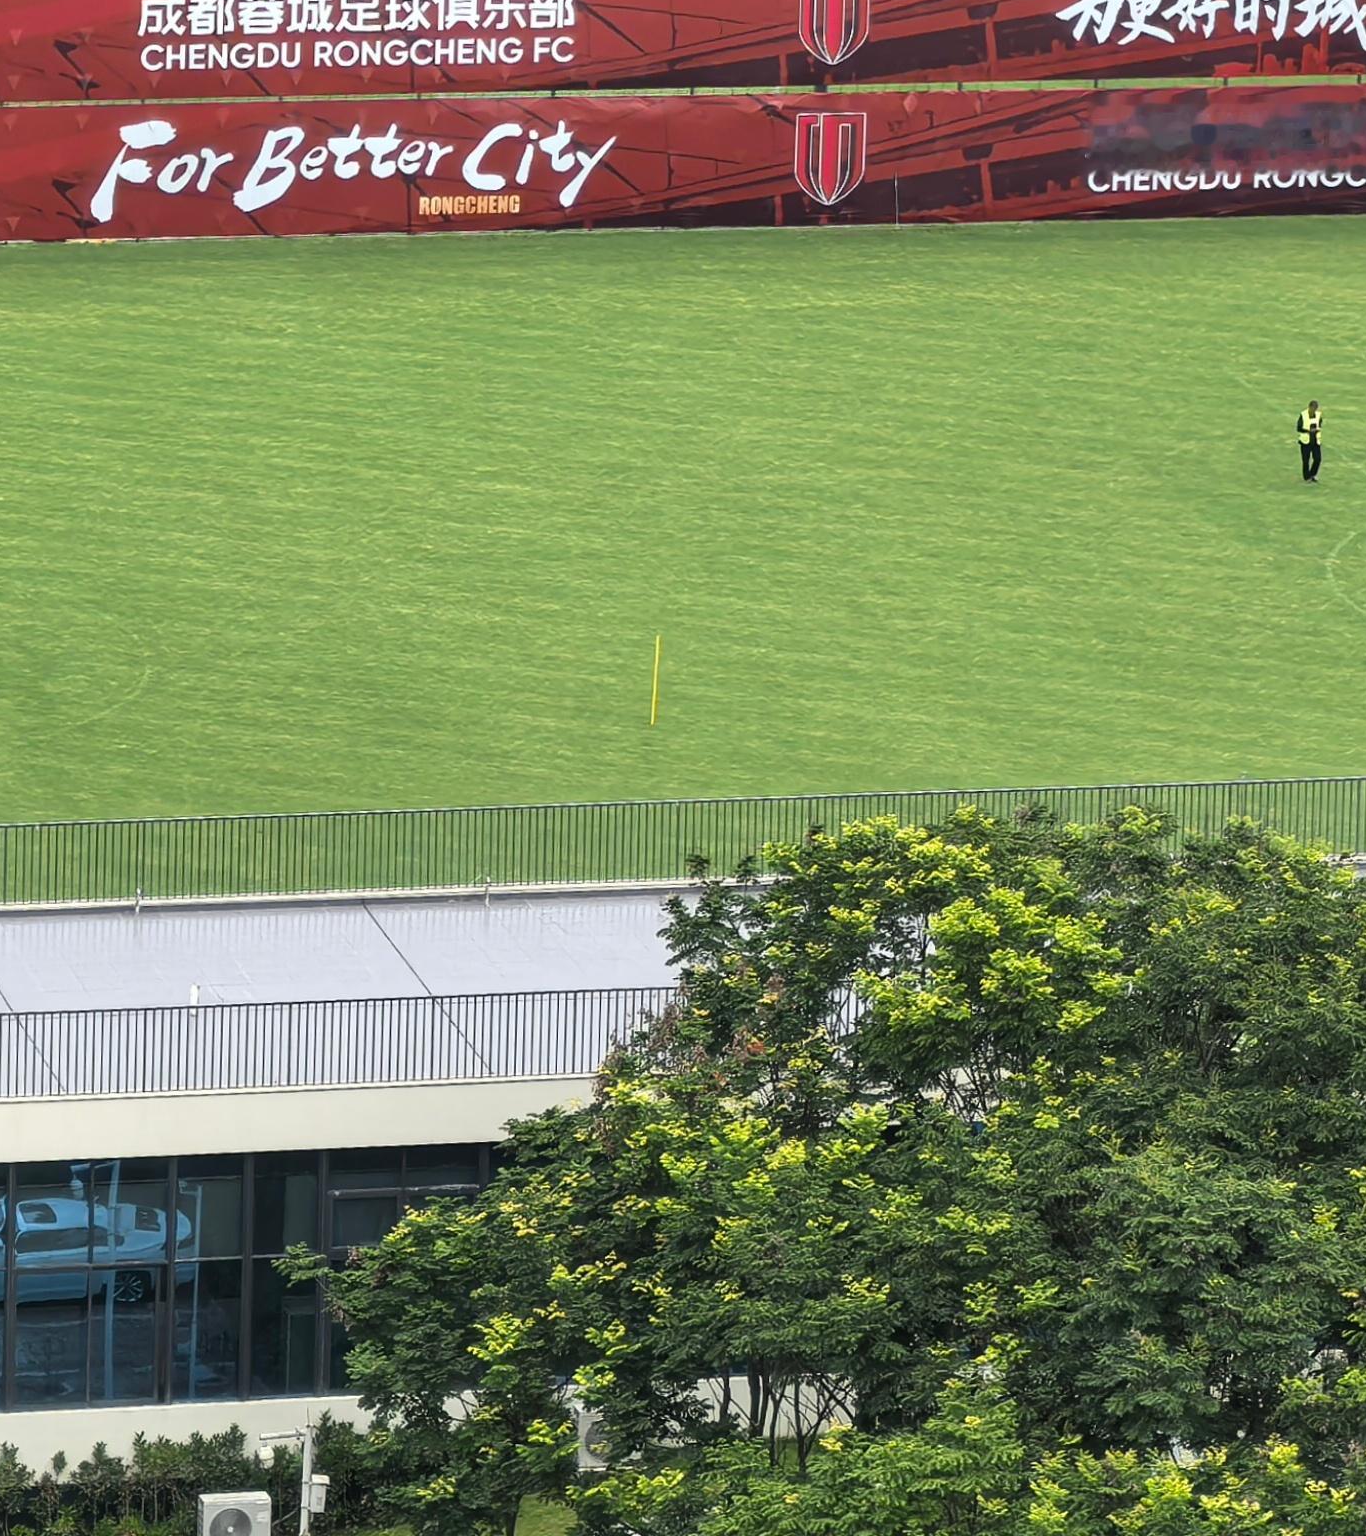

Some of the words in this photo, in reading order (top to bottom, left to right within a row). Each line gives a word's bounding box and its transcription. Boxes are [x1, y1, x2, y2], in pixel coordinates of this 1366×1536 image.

[140, 40, 302, 72] CHENGDU
[312, 37, 524, 69] RONGCHENG
[532, 35, 576, 64] FC
[90, 119, 234, 224] For
[232, 123, 455, 213] Better
[460, 119, 617, 209] City
[418, 195, 522, 215] RONGCHENG
